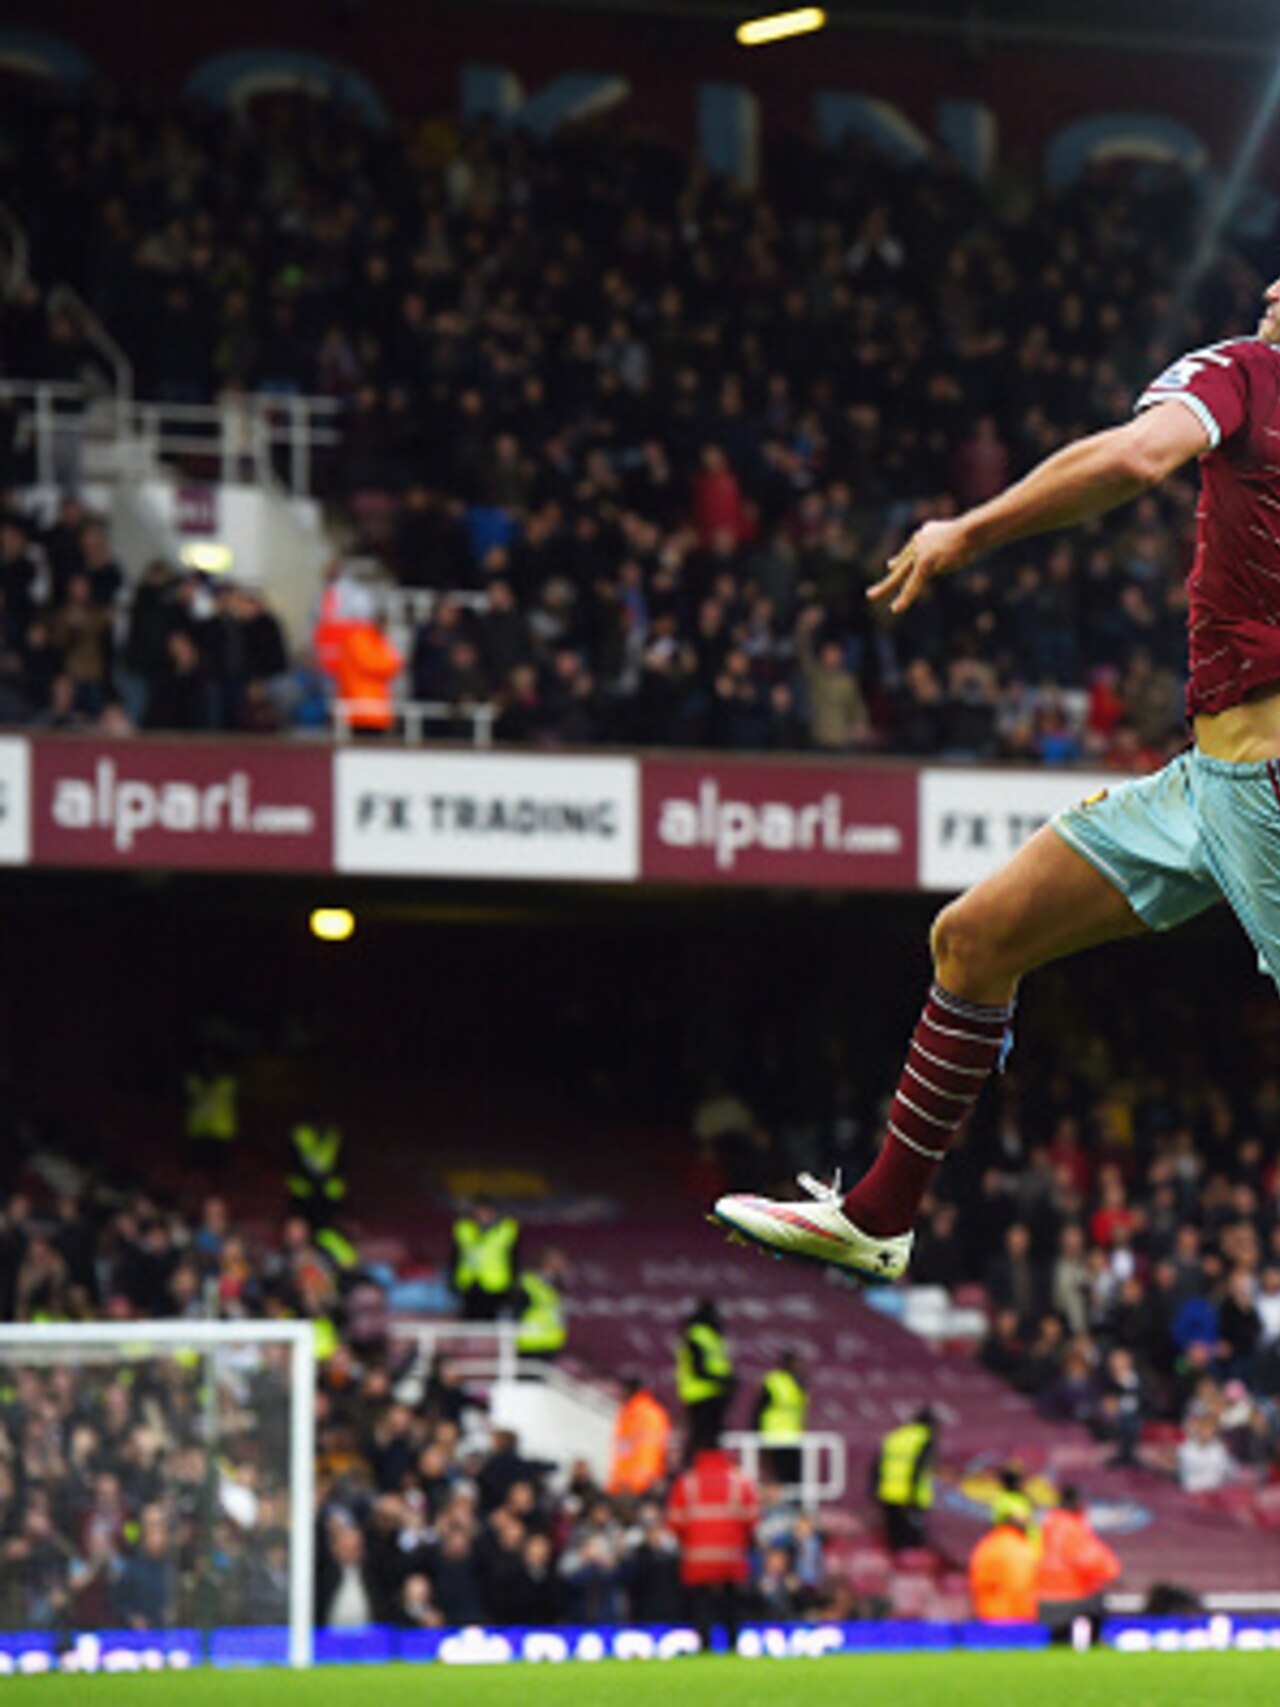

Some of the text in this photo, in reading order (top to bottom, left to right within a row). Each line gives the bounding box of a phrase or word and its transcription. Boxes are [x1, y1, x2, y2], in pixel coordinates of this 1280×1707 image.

[356, 793, 618, 839] FX TRADING
[940, 812, 986, 846] FX
